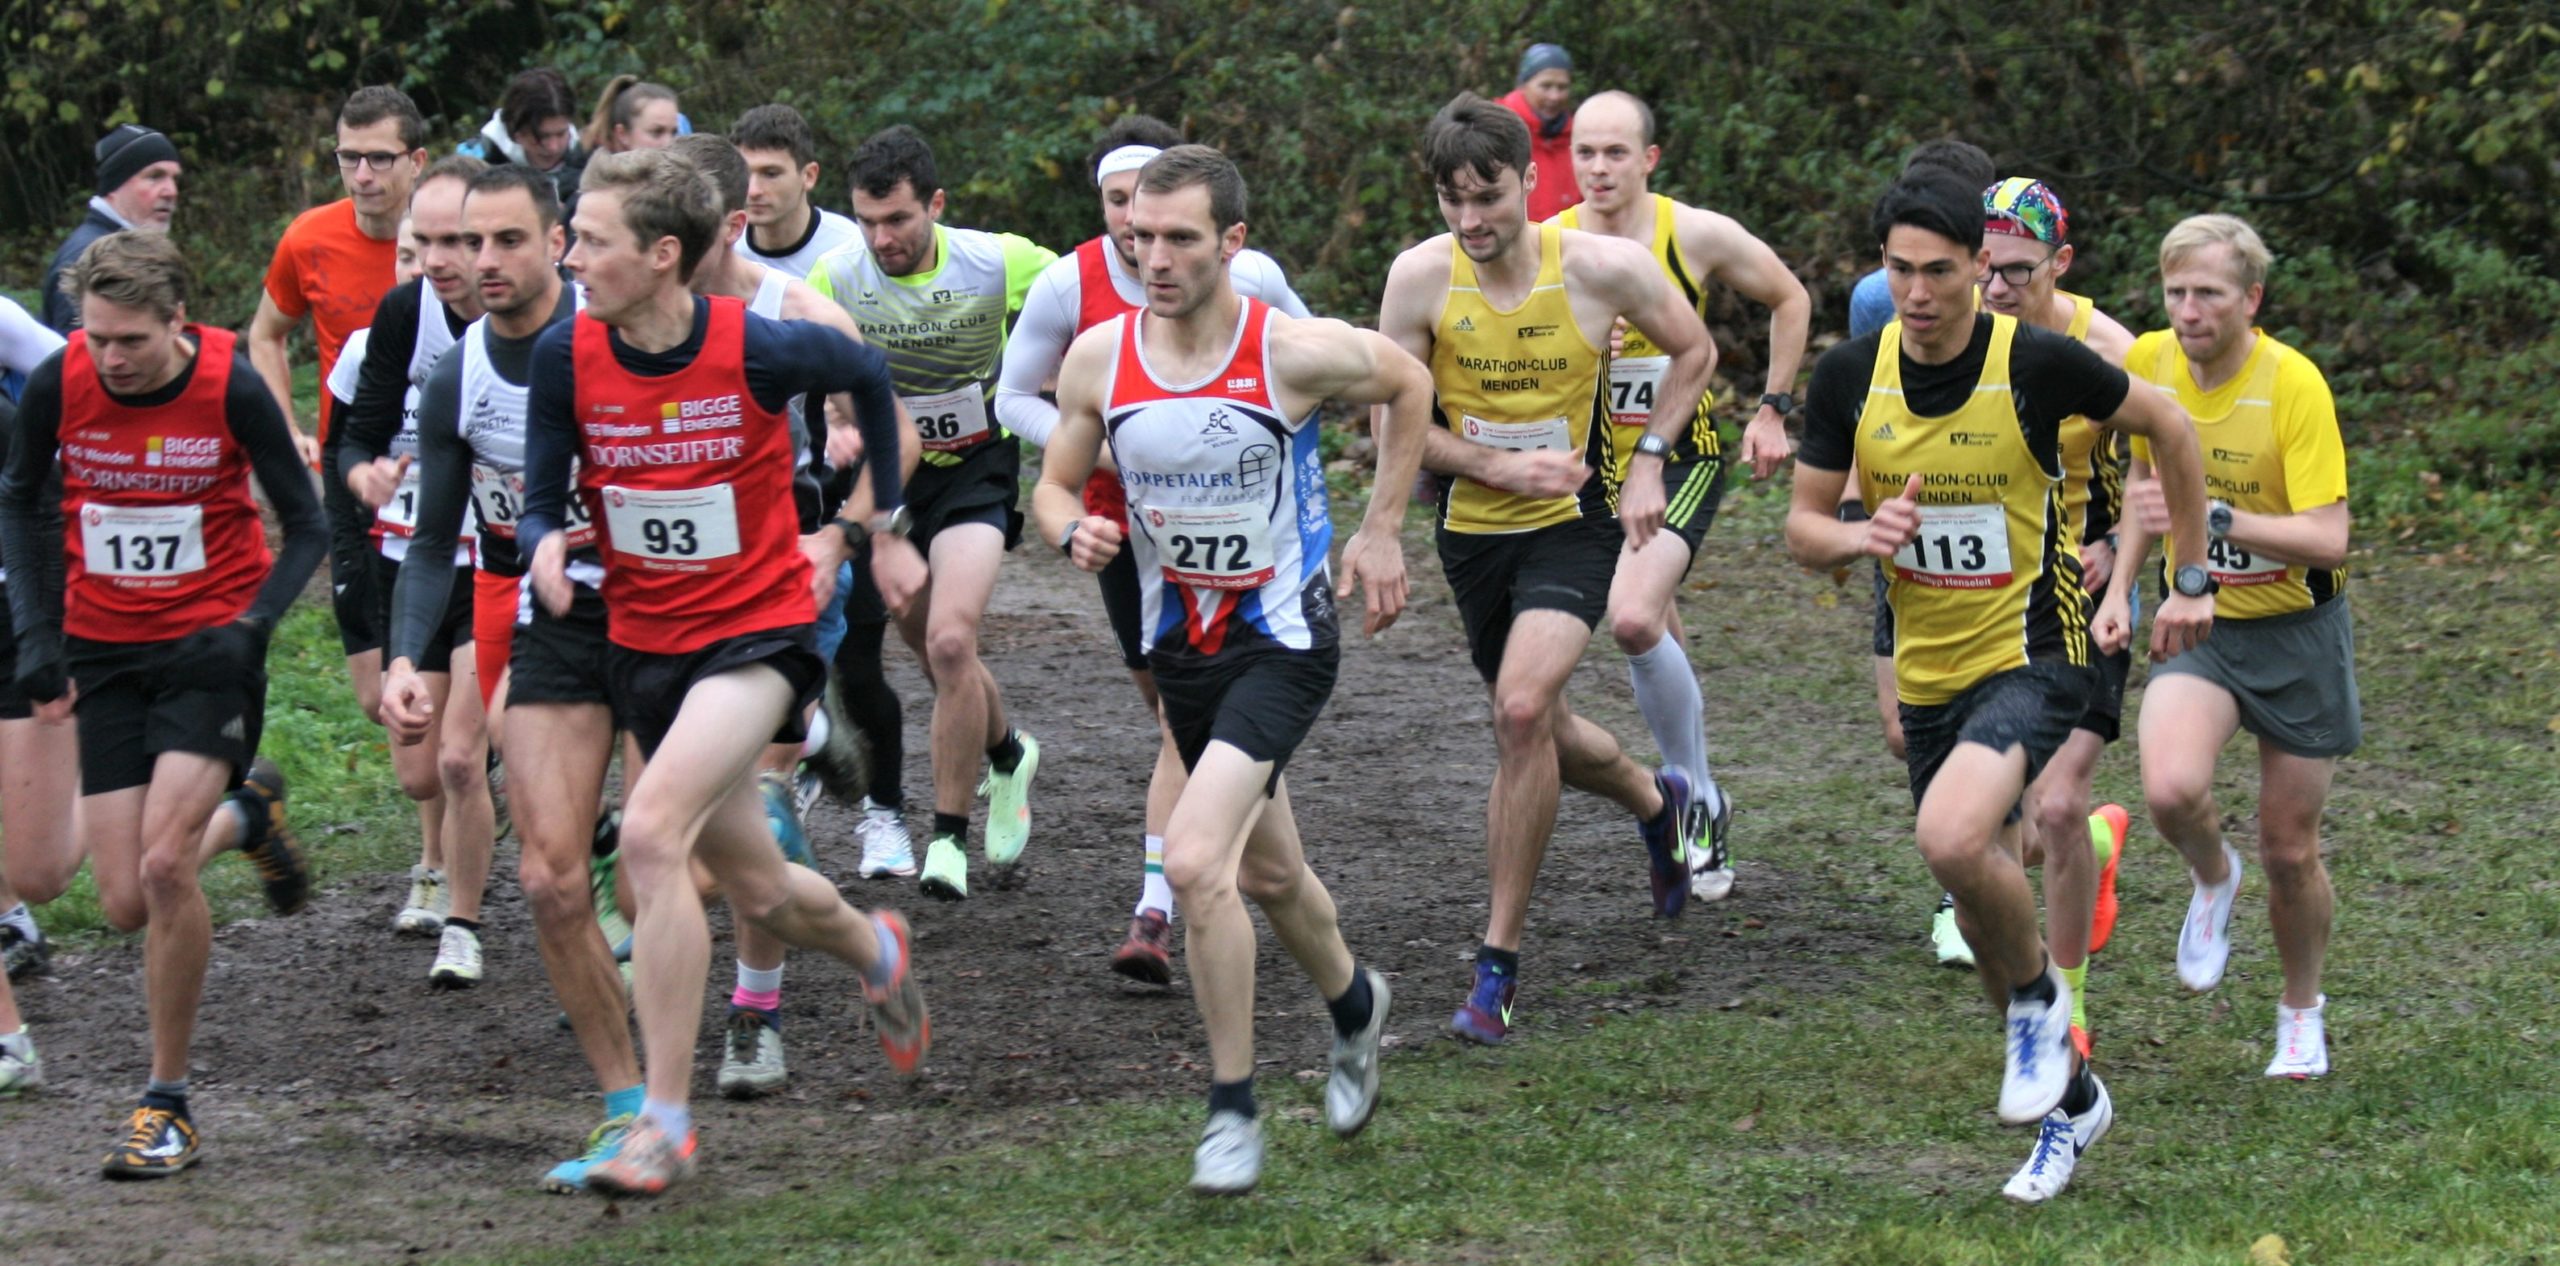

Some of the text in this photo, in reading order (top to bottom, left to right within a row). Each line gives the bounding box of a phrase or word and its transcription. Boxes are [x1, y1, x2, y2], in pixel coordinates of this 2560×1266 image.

[859, 314, 987, 334] MARATHON-CLUB
[887, 335, 956, 349] MENDEN
[1456, 355, 1567, 373] MARATHON-CLUB
[1481, 377, 1539, 391] MENDEN
[1612, 381, 1653, 409] 74
[681, 395, 741, 417] BIGGE
[683, 414, 742, 431] ENERGIE
[916, 413, 959, 439] 36
[164, 437, 221, 454] BIGGE
[1872, 471, 2008, 486] MARAHON-CLUB
[2205, 473, 2260, 494] ON-CLUB
[1915, 490, 1972, 503] ENDEN
[643, 518, 698, 555] 93
[105, 534, 181, 571] 137
[1171, 534, 1251, 571] 272
[1912, 534, 1986, 570] 113
[2207, 536, 2251, 570] 45
[1912, 572, 1991, 587] Philipp Henseleit
